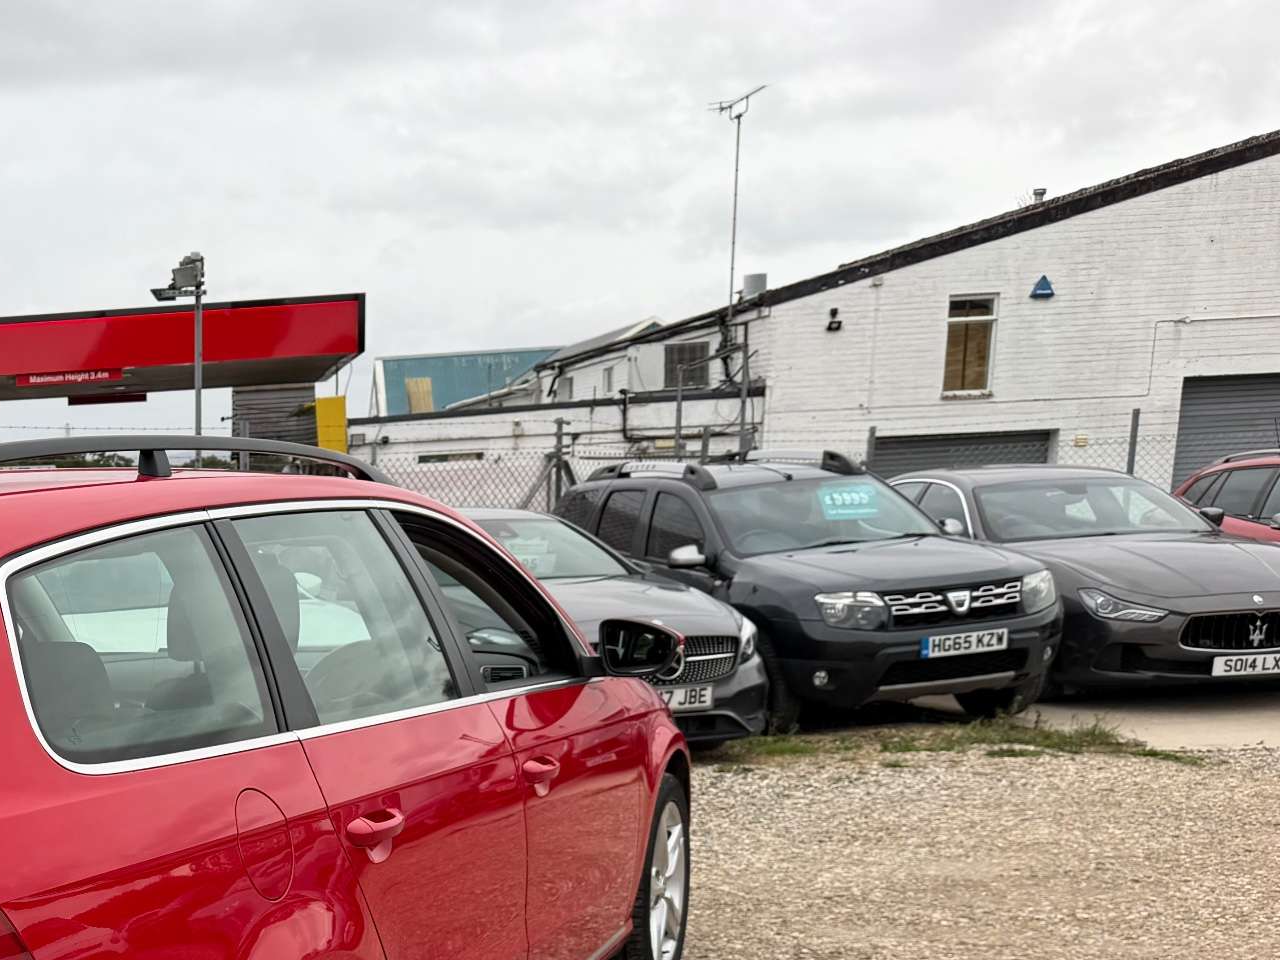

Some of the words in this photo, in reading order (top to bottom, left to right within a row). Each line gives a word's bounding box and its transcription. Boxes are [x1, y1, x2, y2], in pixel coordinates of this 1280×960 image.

[29, 375, 64, 383] Maximum
[65, 373, 89, 382] Height
[90, 371, 109, 380] 3.4m
[931, 635, 972, 653] HG65
[975, 631, 1005, 649] KZW
[678, 687, 707, 706] JBE
